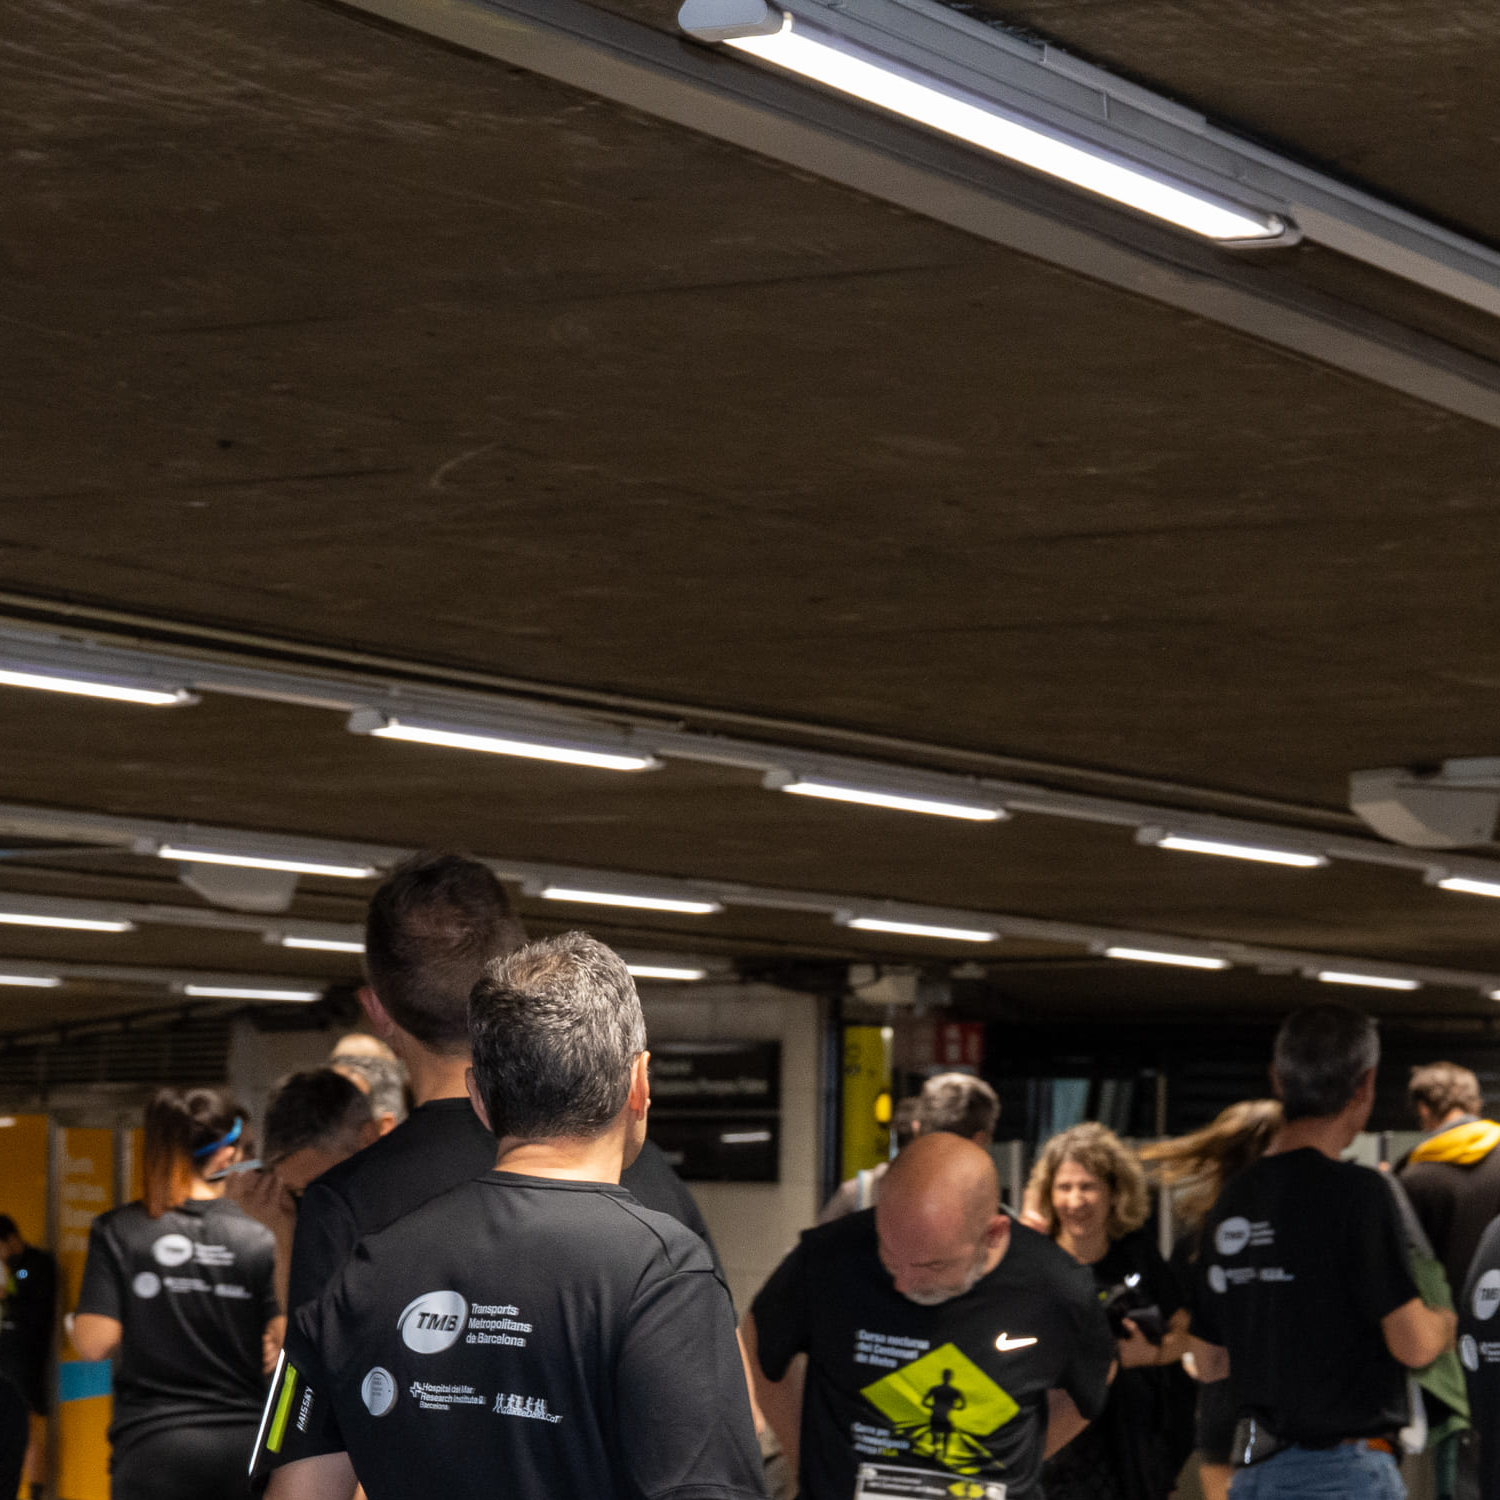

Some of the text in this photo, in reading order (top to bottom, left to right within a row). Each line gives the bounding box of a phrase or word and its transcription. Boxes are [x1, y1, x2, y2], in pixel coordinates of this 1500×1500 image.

[471, 1302, 519, 1316] Transports
[417, 1311, 459, 1332] TMB
[467, 1317, 533, 1334] Metropolitans
[466, 1332, 526, 1348] de Barcelona
